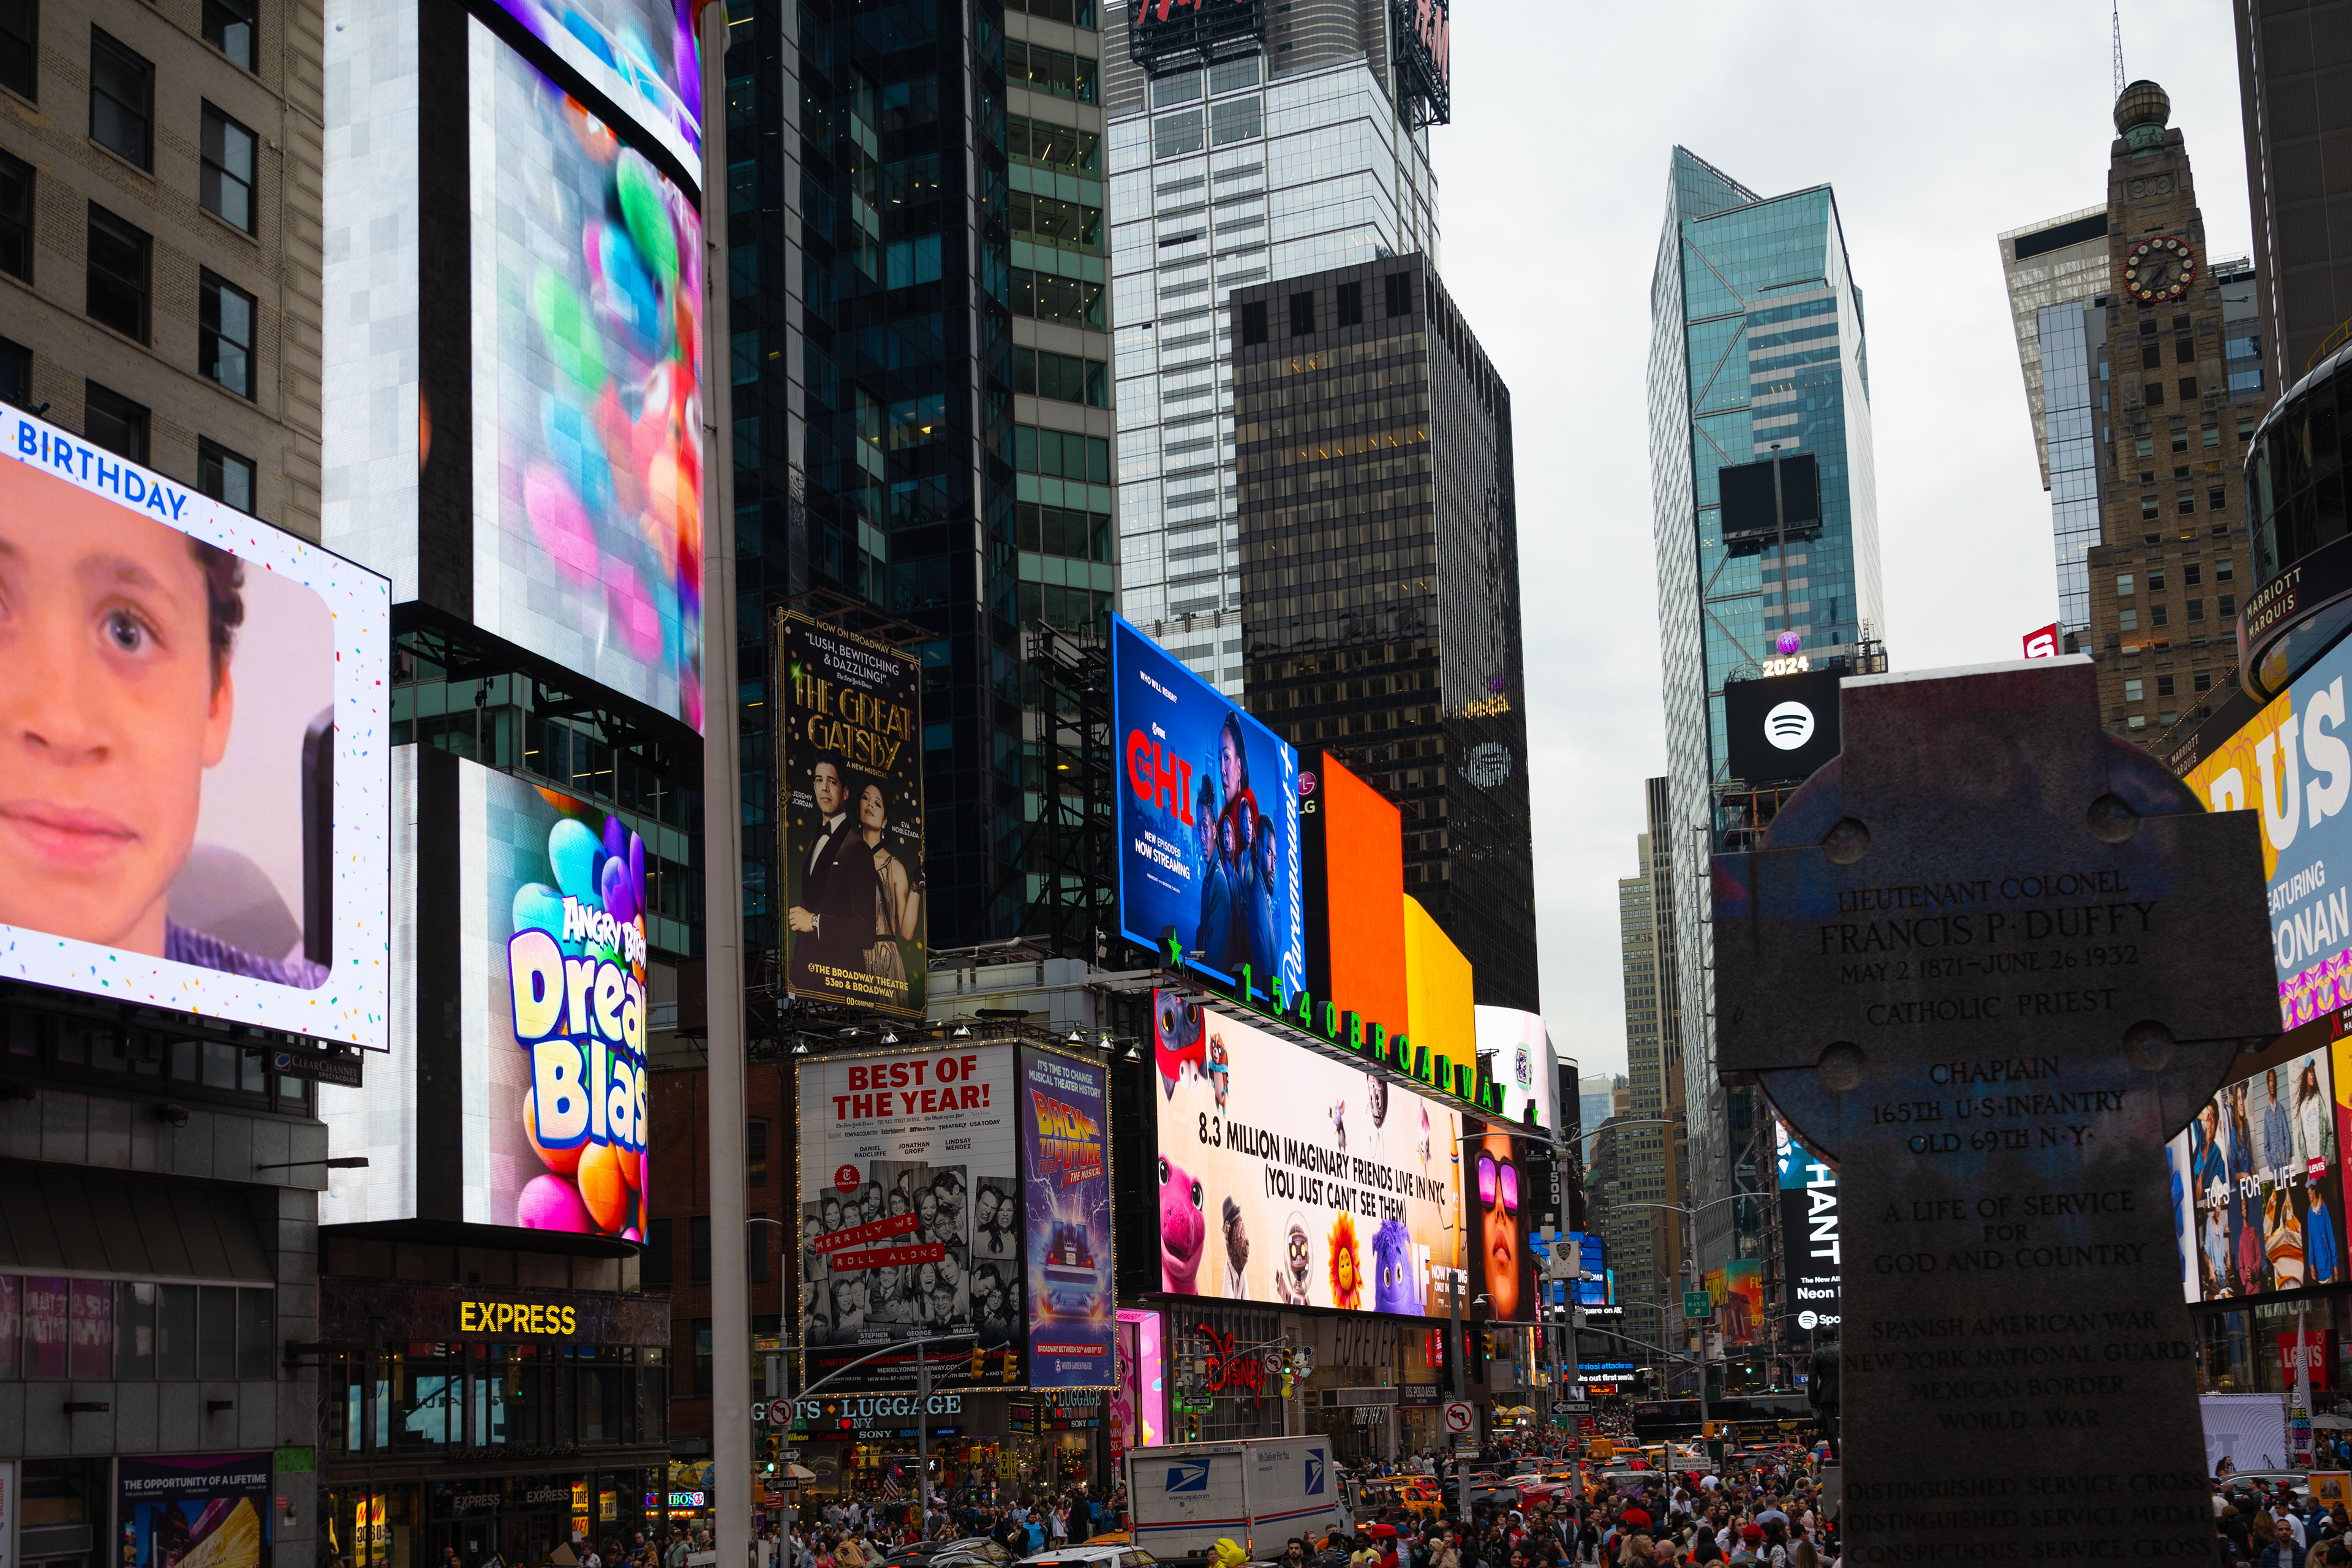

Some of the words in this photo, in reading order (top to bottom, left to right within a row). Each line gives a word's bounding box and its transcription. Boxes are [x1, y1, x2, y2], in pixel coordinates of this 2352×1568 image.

[19, 420, 186, 520] BIRTHDAY
[2247, 567, 2301, 620] MARRIOTT
[2248, 594, 2295, 642] MARQUIS
[817, 620, 835, 633] NOW
[837, 628, 848, 639] ON
[851, 633, 889, 654] BROADWAY
[824, 654, 831, 665] &
[840, 644, 899, 676] BEWITCHING
[1763, 656, 1809, 677] 2024
[1140, 670, 1151, 685] WHO
[1152, 679, 1162, 693] WILL
[1162, 685, 1177, 704] REIGN?
[795, 673, 833, 717] THE
[839, 688, 914, 742] GREAT
[808, 715, 900, 770] GATSBY
[2171, 734, 2199, 766] MARRIOTT
[852, 763, 864, 772] NEW
[864, 766, 888, 779] MUSICAL
[1127, 728, 1193, 827] CHI
[1137, 755, 1153, 778] THE
[792, 798, 813, 808] JORDAN
[793, 791, 812, 801] JEREMY
[892, 826, 919, 839] NOBLEZADA
[1144, 830, 1156, 845] NEW
[1157, 838, 1181, 858] EPISODES
[1134, 838, 1152, 859] NOW
[1153, 848, 1191, 880] STREAMING
[1839, 880, 1991, 913] LIEUTENANT
[2000, 870, 2128, 899] COLONEL
[562, 895, 621, 955] ANGRY
[1817, 914, 1973, 956] FRANCIS
[2026, 900, 2158, 941] DUFFY
[815, 963, 830, 976] THE
[832, 967, 874, 984] BROADWAY
[876, 976, 908, 991] THEATRE
[825, 977, 843, 989] 53RD
[845, 981, 851, 989] &
[853, 981, 894, 998] BROADWAY
[1867, 996, 2002, 1026] CATHOLIC
[2018, 988, 2116, 1017] PRIEST
[848, 1060, 929, 1091] BEST
[936, 1055, 977, 1083] OF
[1038, 1060, 1048, 1072] IT'S
[1049, 1063, 1061, 1076] TIME
[1062, 1067, 1070, 1078] TO
[1071, 1069, 1093, 1085] CHANGE
[1351, 1011, 1506, 1114] BROADWAY
[1929, 1056, 2059, 1085] CHAPLAIN
[318, 1071, 358, 1084] SPECTACOLOR
[1029, 1069, 1054, 1086] MUSICAL
[1054, 1077, 1078, 1093] THEATER
[1079, 1084, 1101, 1098] HISTORY
[533, 1038, 646, 1147] Blas
[832, 1091, 892, 1120] THE
[899, 1084, 990, 1115] YEAR!
[1030, 1088, 1093, 1140] BACK
[1038, 1159, 1054, 1175] THE
[1054, 1139, 1101, 1173] FUTURE
[1039, 1137, 1054, 1158] TO
[1199, 1112, 1221, 1148] 8.3
[1226, 1121, 1280, 1162] MILLION
[1284, 1137, 1349, 1180] IMAGINARY
[1353, 1156, 1392, 1191] FRIENDS
[1396, 1170, 1412, 1196] LIVE
[1415, 1177, 1426, 1201] IN
[1428, 1180, 1446, 1205] NYC
[1070, 1172, 1080, 1183] THE
[1081, 1166, 1101, 1180] MUSICAL
[2204, 1182, 2230, 1209] TOPS
[2239, 1174, 2261, 1200] FOR
[2274, 1164, 2297, 1191] LIFE
[1265, 1163, 1294, 1199] (YOU
[1298, 1176, 1323, 1207] JUST
[1327, 1183, 1358, 1213] CAN'T
[1361, 1193, 1376, 1218] SEE
[1380, 1197, 1407, 1226] THEM)
[1883, 1204, 1901, 1224] A
[1913, 1199, 1965, 1221] LIFE
[1977, 1197, 2011, 1218] OF
[2024, 1191, 2135, 1216] SERVICE
[815, 1225, 883, 1250] MERRILY
[895, 1217, 913, 1227] WE
[837, 1256, 874, 1266] ROLL
[889, 1249, 937, 1261] ALONG
[1412, 1243, 1430, 1305] IF
[1797, 1287, 1834, 1299] Neon
[461, 1302, 576, 1335] EXPRESS
[1334, 1316, 1396, 1366] FOREVER
[1058, 1390, 1101, 1406] LUGGAGE
[1413, 1386, 1425, 1397] POLO
[1425, 1386, 1437, 1397] ASSN.
[1353, 1408, 1376, 1425] FOREVER
[1378, 1406, 1387, 1423] 21
[2292, 1409, 2307, 1418] FREE
[2292, 1418, 2310, 1429] MUSIC
[817, 1431, 849, 1441] Canon
[859, 1430, 892, 1439] SONY
[2294, 1439, 2308, 1450] ART
[1258, 1453, 1264, 1462] We
[1265, 1452, 1276, 1461] Deliver
[124, 1480, 142, 1490] THE
[144, 1476, 207, 1489] OPPORTUNITY
[209, 1476, 220, 1485] OF
[222, 1476, 228, 1485] A
[230, 1474, 266, 1484] LIFETIME
[527, 1488, 570, 1503] EXPRESS
[454, 1493, 500, 1509] EXPRESS
